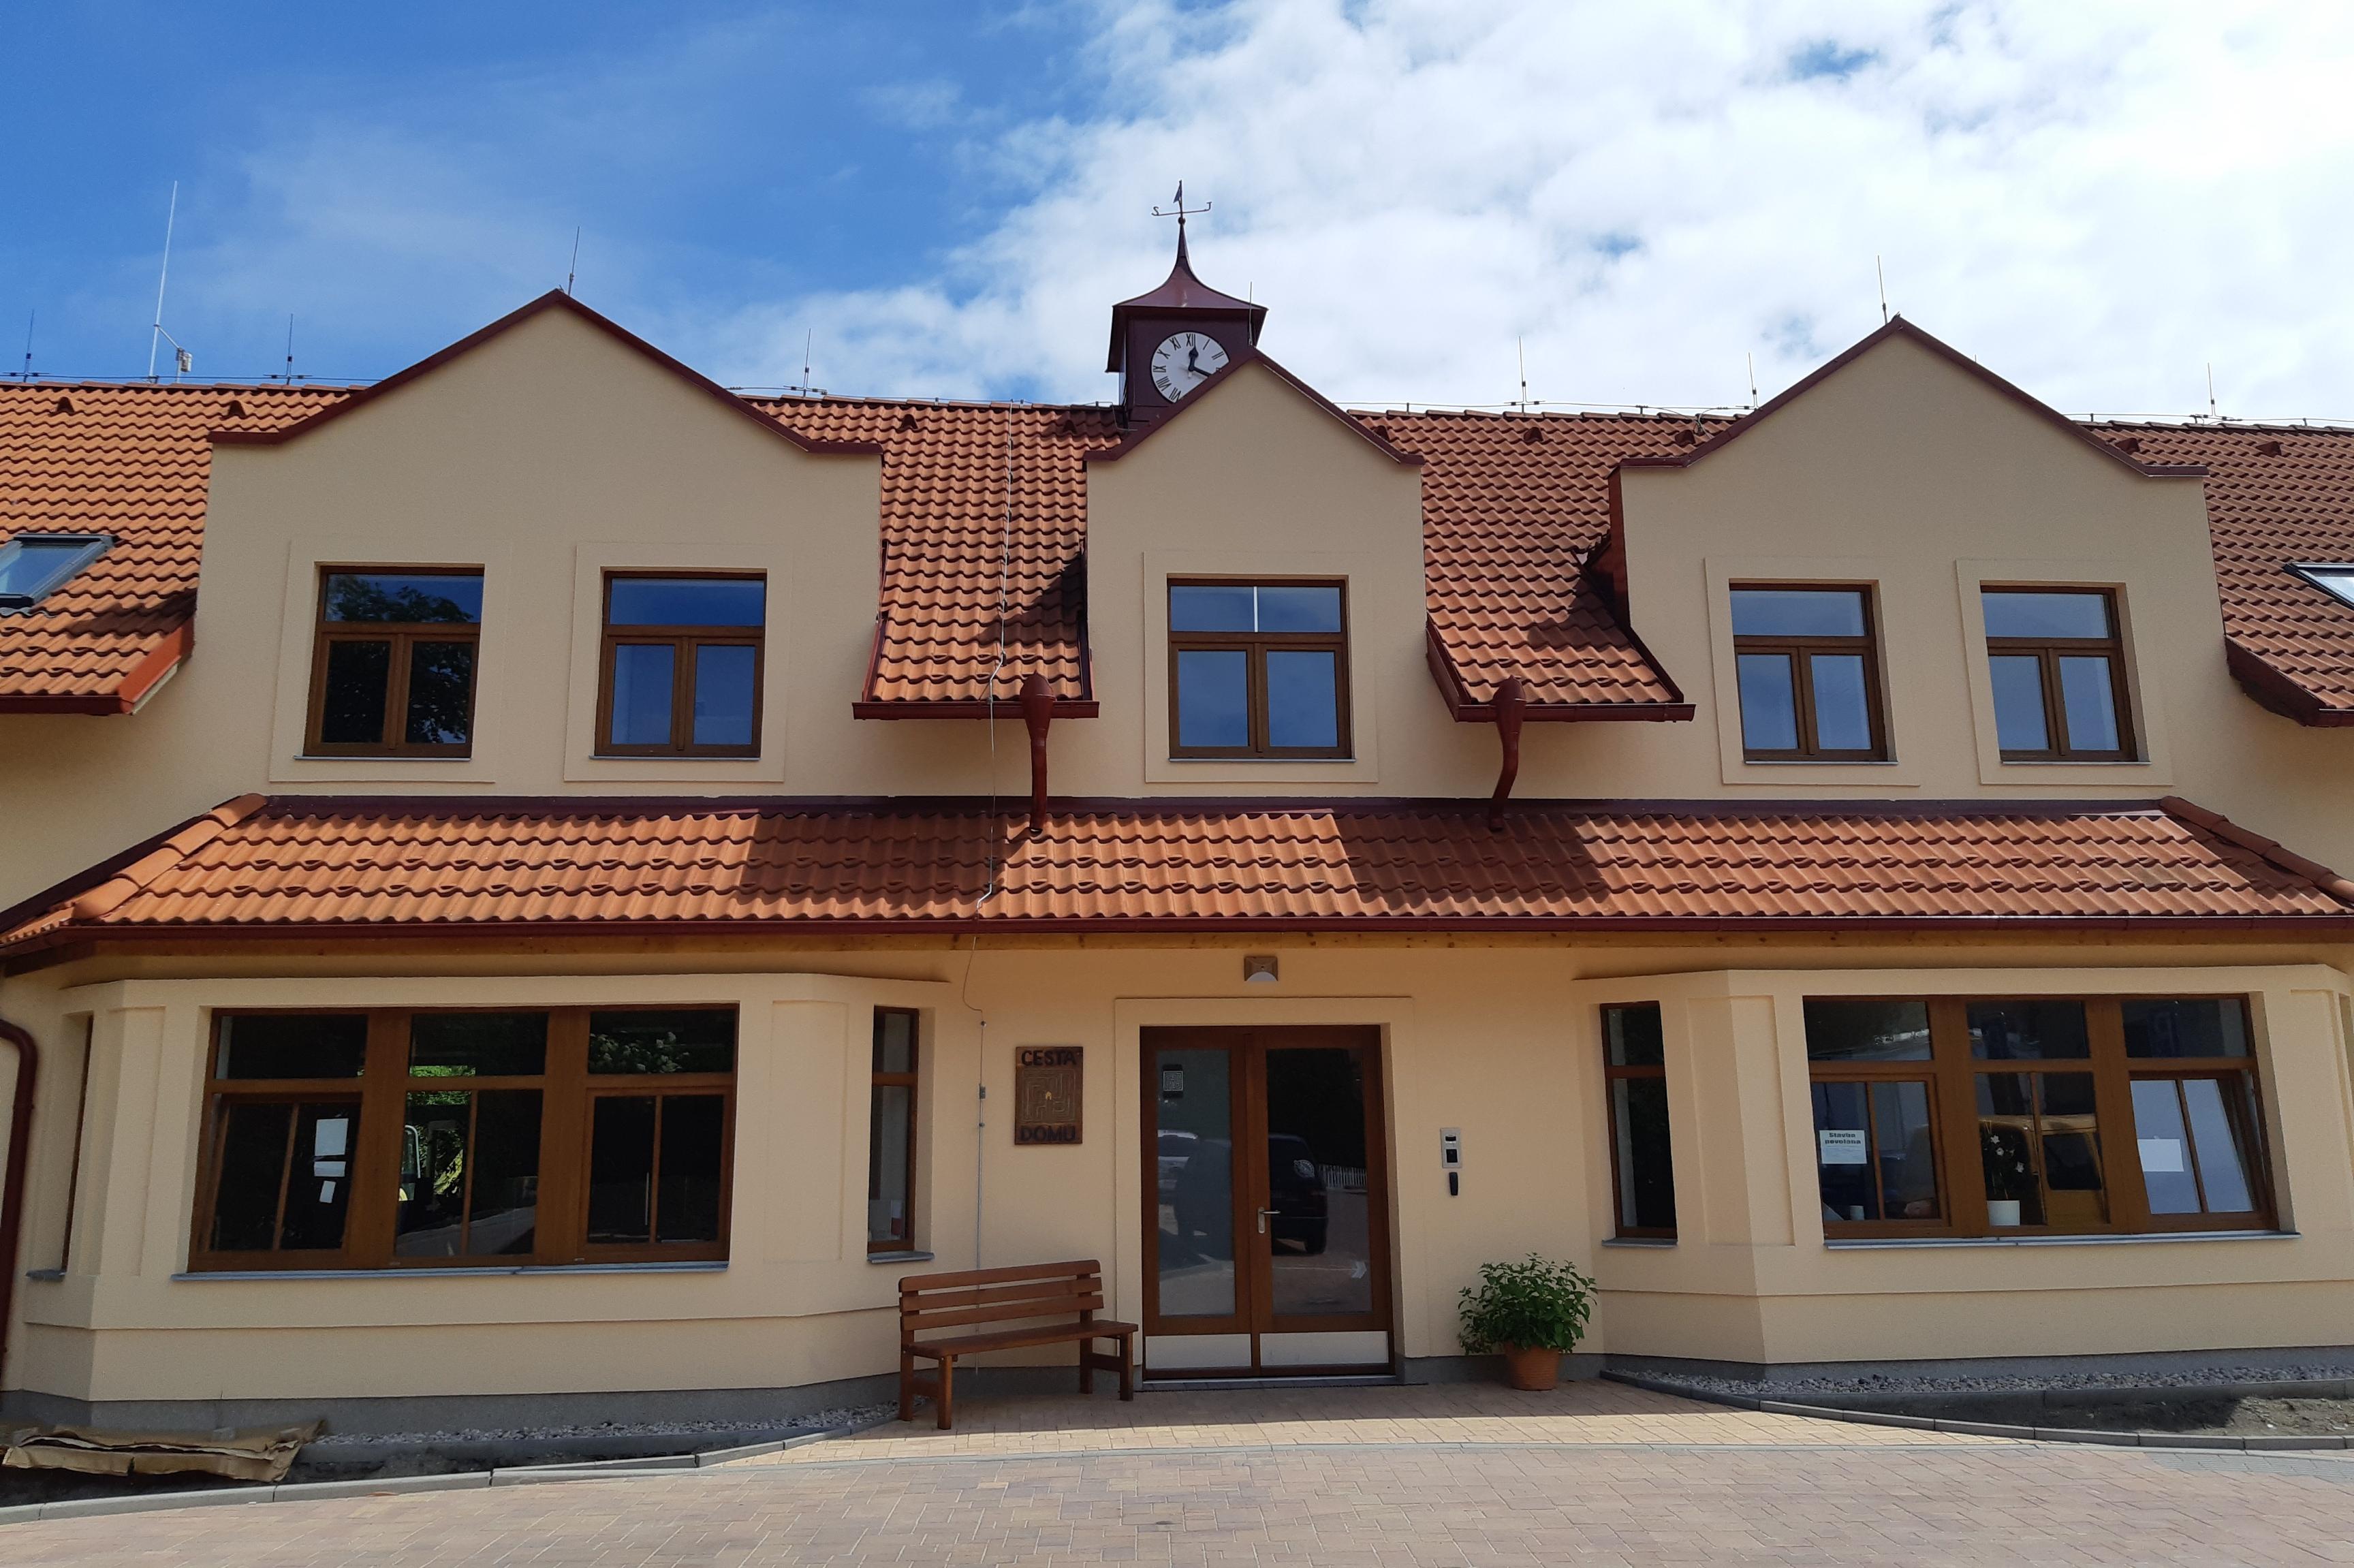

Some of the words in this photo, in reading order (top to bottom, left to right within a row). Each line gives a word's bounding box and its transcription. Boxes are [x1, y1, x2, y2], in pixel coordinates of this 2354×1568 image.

[1169, 336, 1182, 351] XI
[1157, 349, 1171, 360] X
[1022, 1050, 1077, 1066] CESTA
[1020, 1125, 1076, 1142] DOMU
